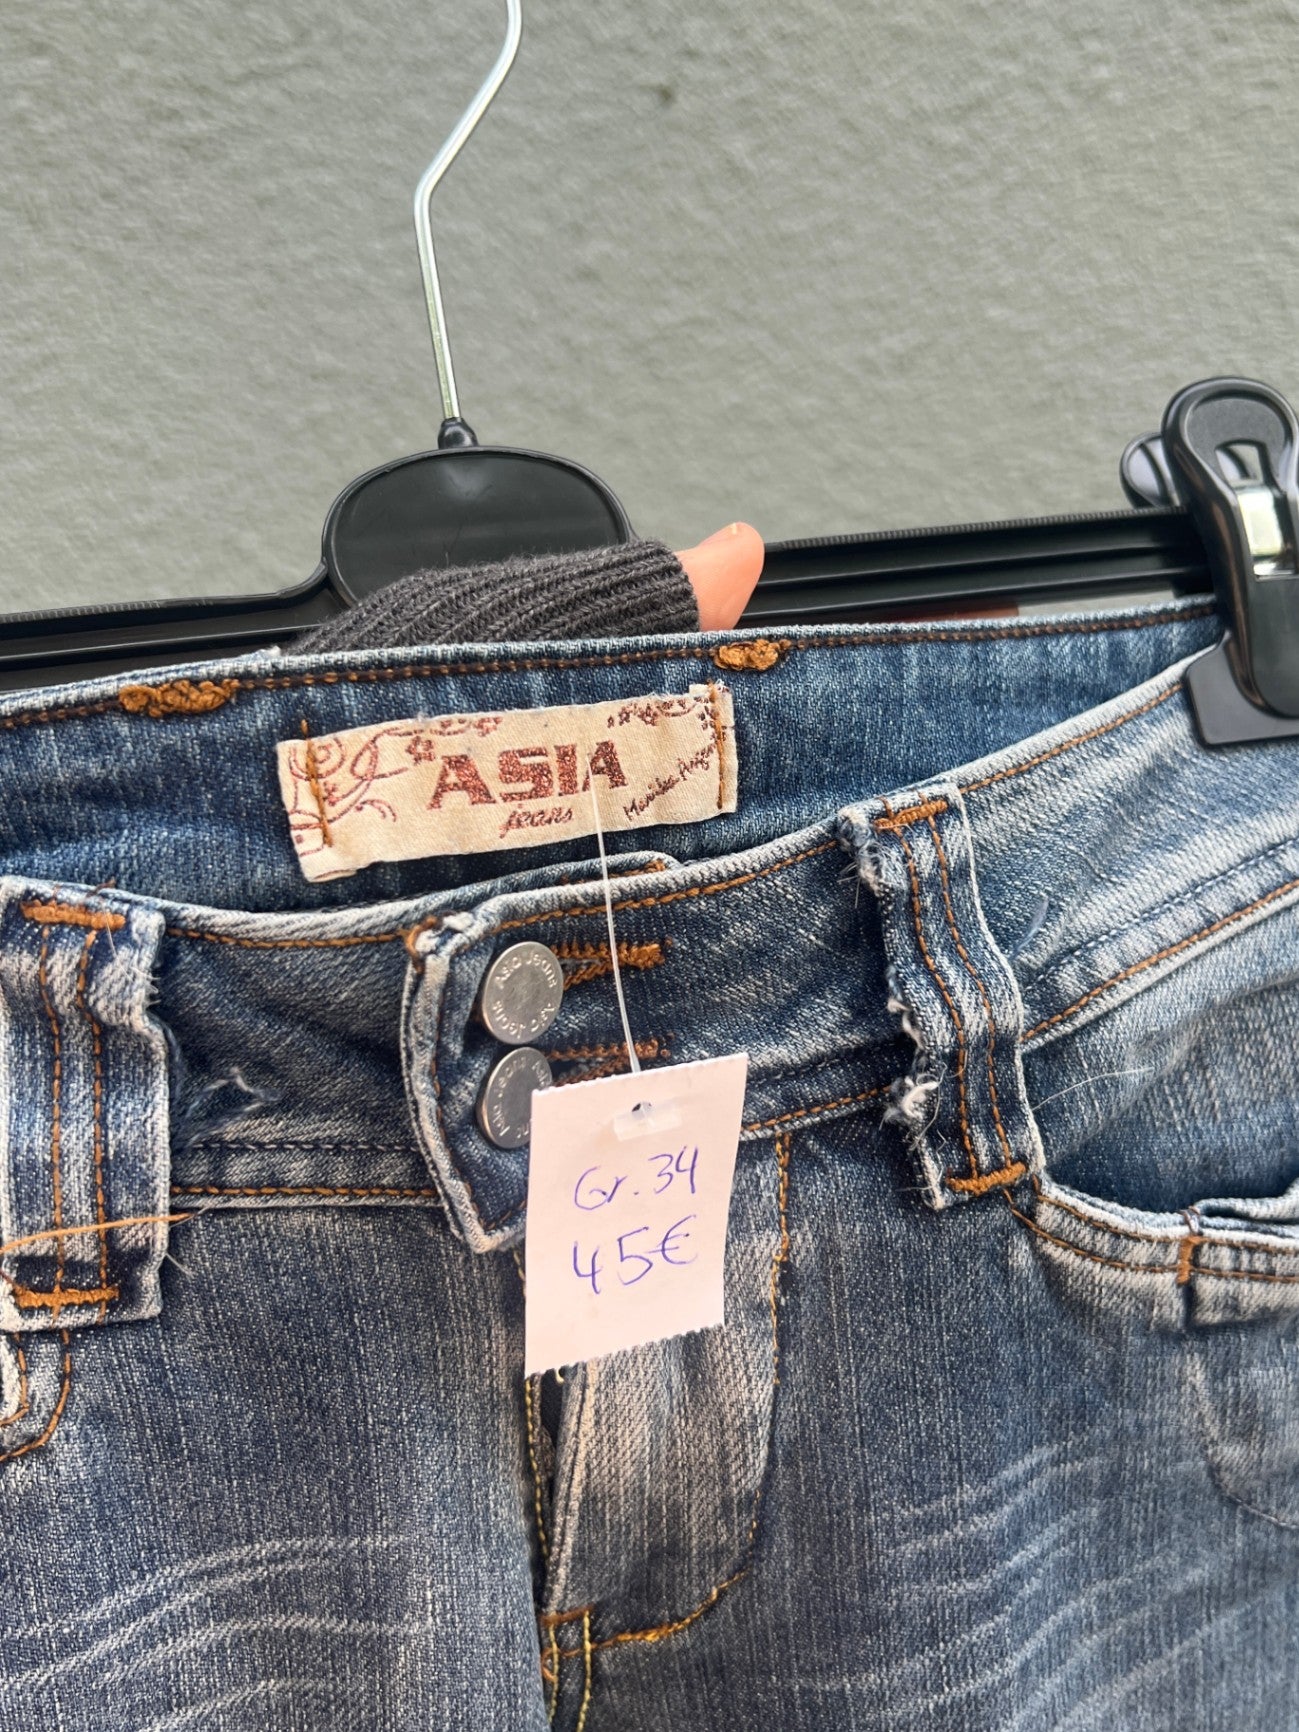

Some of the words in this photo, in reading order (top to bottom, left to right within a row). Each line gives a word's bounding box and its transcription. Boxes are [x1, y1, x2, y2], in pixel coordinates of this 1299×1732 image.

[427, 739, 629, 810] ASIA
[499, 803, 573, 839] jeans
[572, 1213, 699, 1295] 45€
